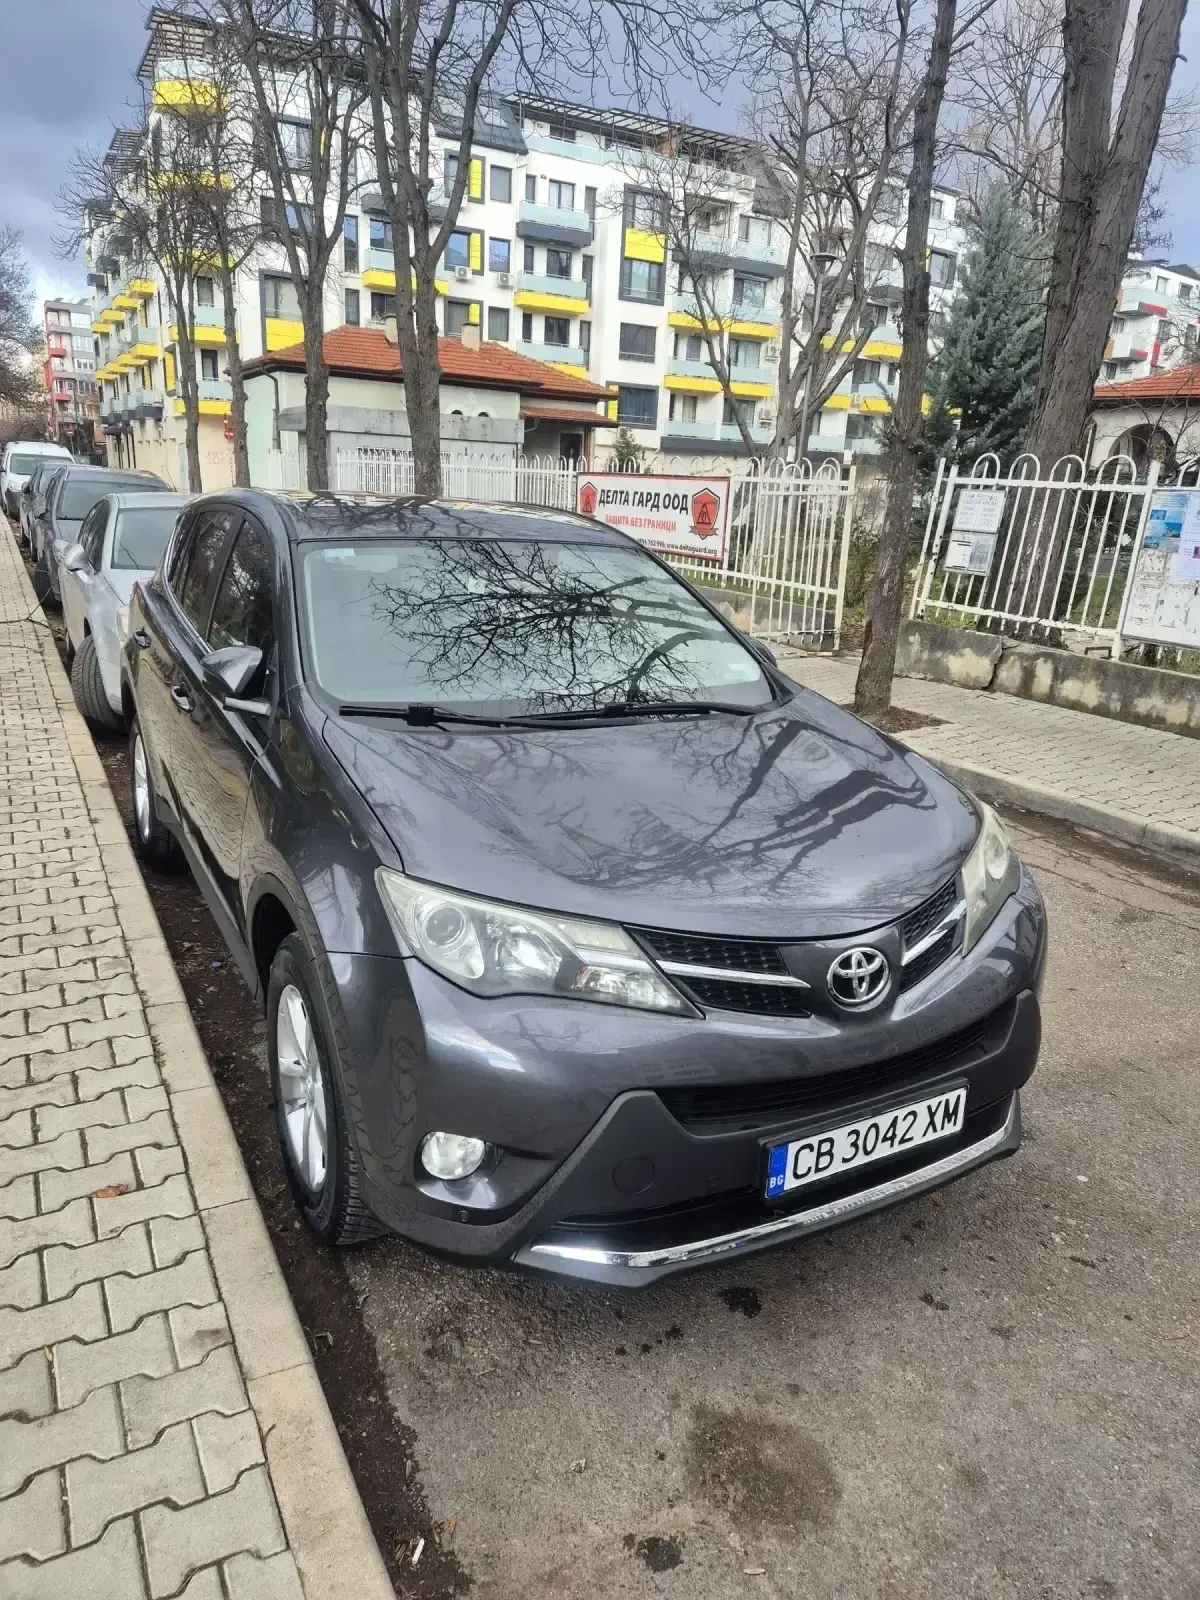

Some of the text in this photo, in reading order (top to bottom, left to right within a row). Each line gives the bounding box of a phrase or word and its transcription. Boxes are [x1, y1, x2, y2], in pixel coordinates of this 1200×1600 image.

[598, 489, 689, 515] ДЕЛТА ГАРД ООД
[605, 514, 677, 532] ЗАЩИТА БЕЗ ГРАНИЦИ
[666, 543, 718, 557] www.deltaguard.org
[792, 1094, 962, 1180] CB 3042 XM
[769, 1174, 784, 1189] BG
